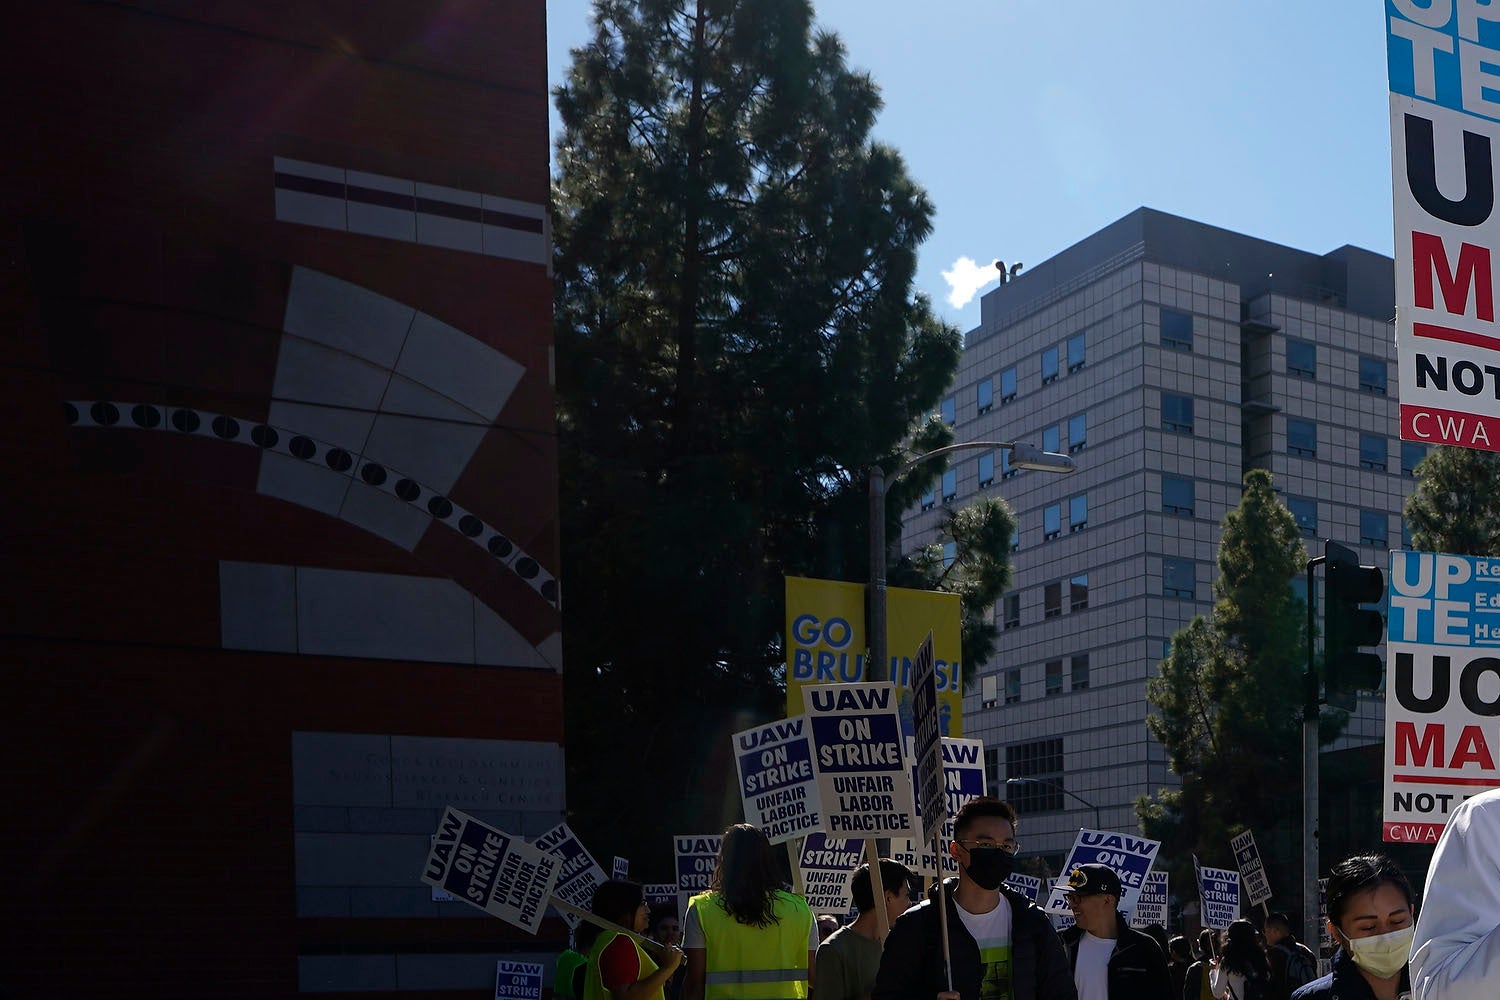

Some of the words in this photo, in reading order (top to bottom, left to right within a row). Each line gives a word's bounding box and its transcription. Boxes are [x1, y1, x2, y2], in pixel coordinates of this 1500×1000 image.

[1412, 413, 1491, 447] CWA
[1392, 552, 1472, 600] UP
[1392, 598, 1471, 645] TE
[792, 614, 853, 650] GO
[811, 688, 890, 711] UAW
[740, 720, 804, 751] UAW
[838, 717, 871, 741] ON
[761, 744, 789, 768] ON
[819, 742, 899, 767] STRIKE
[942, 744, 979, 764] AW
[745, 759, 811, 792] STRIKE
[832, 776, 894, 793] UNFAIR
[756, 786, 807, 811] UNFAIR
[839, 795, 894, 811] LABOR
[1393, 792, 1453, 813] NOT
[761, 801, 806, 825] LABOR
[829, 813, 911, 831] PRACTICE
[763, 812, 820, 839] RACTICE
[1390, 826, 1437, 840] CWA
[427, 813, 462, 881] UAW
[536, 826, 567, 851] AW
[1081, 833, 1157, 855] UAW
[1233, 833, 1252, 850] UAW
[454, 842, 478, 874] ON
[466, 832, 504, 901] STRIKE
[694, 858, 715, 872] ON
[804, 851, 858, 867] STRIKE
[1096, 851, 1126, 867] ON
[1241, 857, 1261, 876] STRIKE
[493, 852, 522, 904] UNFAIR
[509, 861, 536, 909] LABOR
[681, 873, 713, 888] STRI
[806, 871, 847, 883] UNFAIR
[1204, 870, 1237, 881] UAW
[519, 857, 555, 927] PRACTICE
[805, 885, 841, 896] LABOR
[1144, 884, 1157, 893] ON
[1205, 890, 1238, 903] STRIKE
[1214, 882, 1228, 892] ON
[1208, 903, 1234, 913] UNFAIR
[1210, 911, 1233, 920] LABOR
[501, 963, 540, 974] UAW
[499, 985, 539, 997] STRIKE
[511, 976, 528, 986] ON
